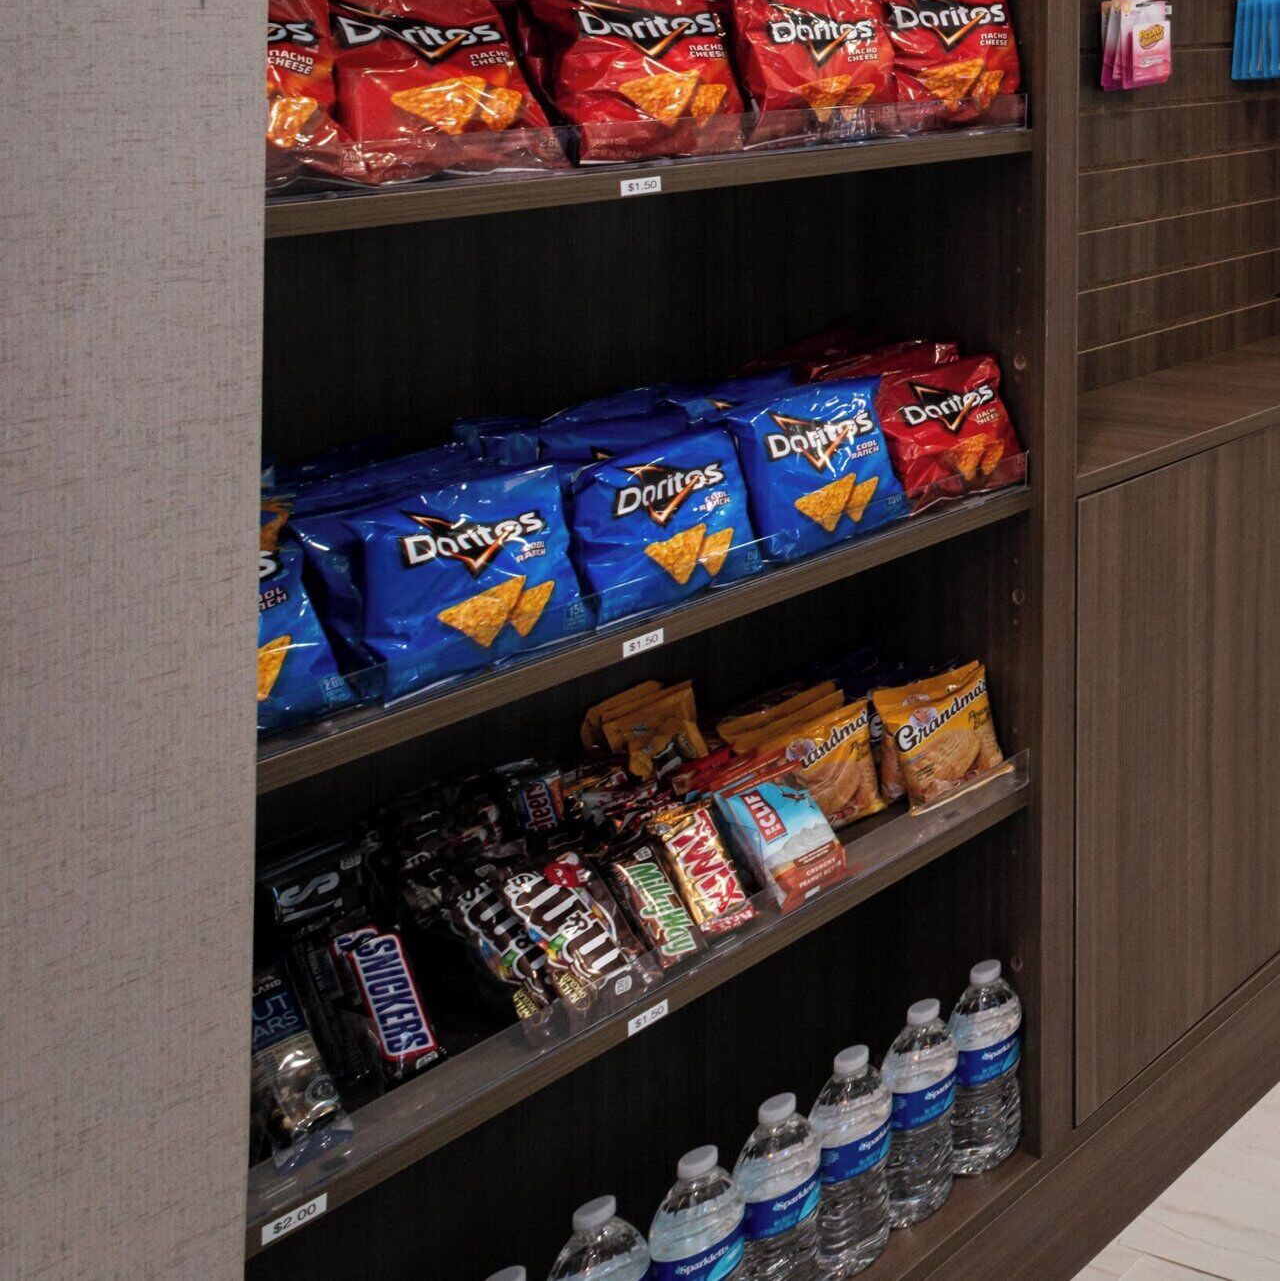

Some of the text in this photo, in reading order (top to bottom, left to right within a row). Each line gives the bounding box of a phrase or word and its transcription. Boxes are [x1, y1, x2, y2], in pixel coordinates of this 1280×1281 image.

[578, 11, 717, 39] Doritos
[894, 4, 1006, 29] Doritos
[337, 16, 500, 46] Doritos
[771, 20, 874, 43] Doritos
[979, 39, 1008, 47] CHEESE
[268, 49, 314, 65] NACHO
[847, 53, 878, 62] CHEESE
[848, 47, 878, 55] NACHO
[267, 56, 313, 75] CHEESE
[627, 179, 657, 192] $1.50
[905, 385, 994, 426] Doritos
[767, 411, 874, 459] Doritos
[855, 440, 878, 452] COOL
[851, 445, 881, 460] RANCH
[617, 464, 724, 516] Doritos
[404, 512, 544, 565] Doritos
[628, 633, 659, 652] $1.50
[743, 794, 777, 828] CLIF
[764, 824, 783, 836] BAR
[666, 808, 746, 914] TWIX
[806, 857, 837, 876] CRUNCHY
[352, 936, 434, 1055] SNICKERS
[635, 1005, 664, 1029] $1.50
[273, 1203, 317, 1235] $2.00
[680, 1244, 730, 1276] Sparkletts
